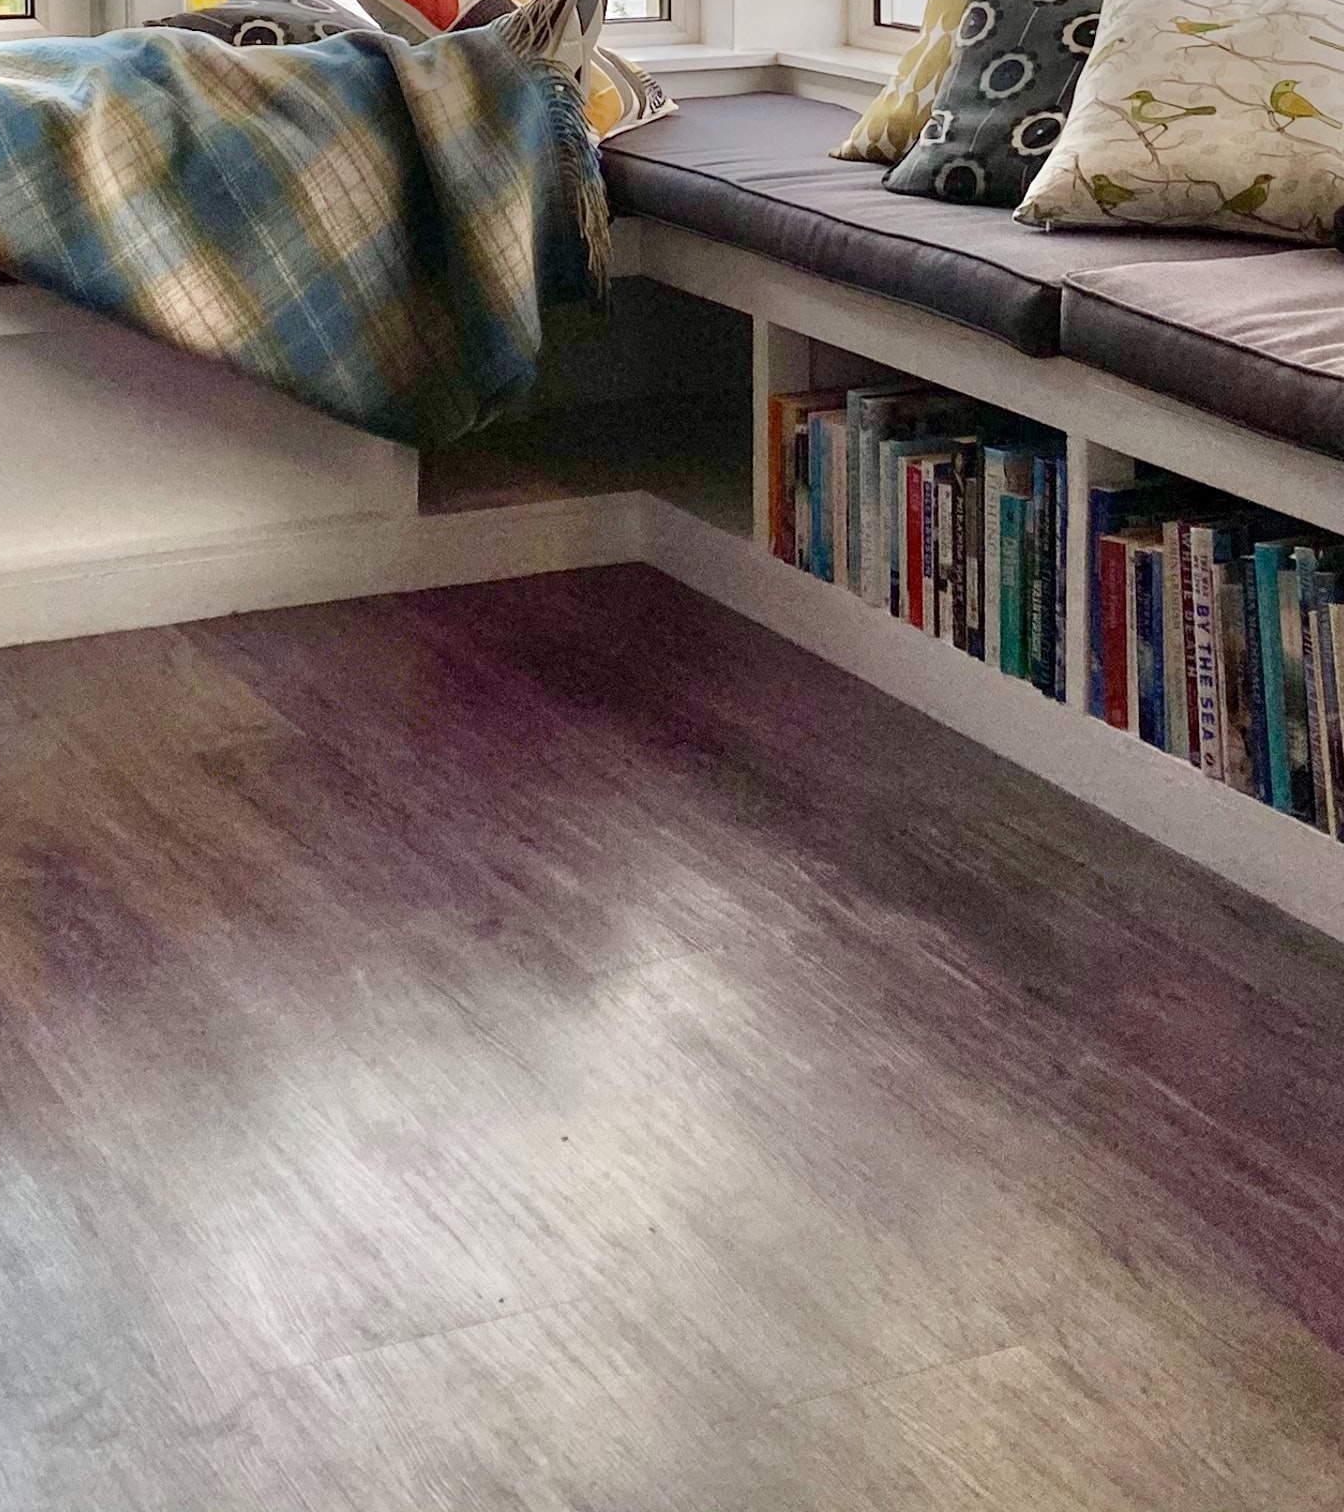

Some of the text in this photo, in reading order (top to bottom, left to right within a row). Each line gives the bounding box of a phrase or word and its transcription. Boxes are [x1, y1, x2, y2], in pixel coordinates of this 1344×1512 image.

[956, 496, 965, 602] MIRANDA HART
[1181, 533, 1197, 678] WHITE DEATH
[1196, 605, 1216, 740] BY THE SEA
